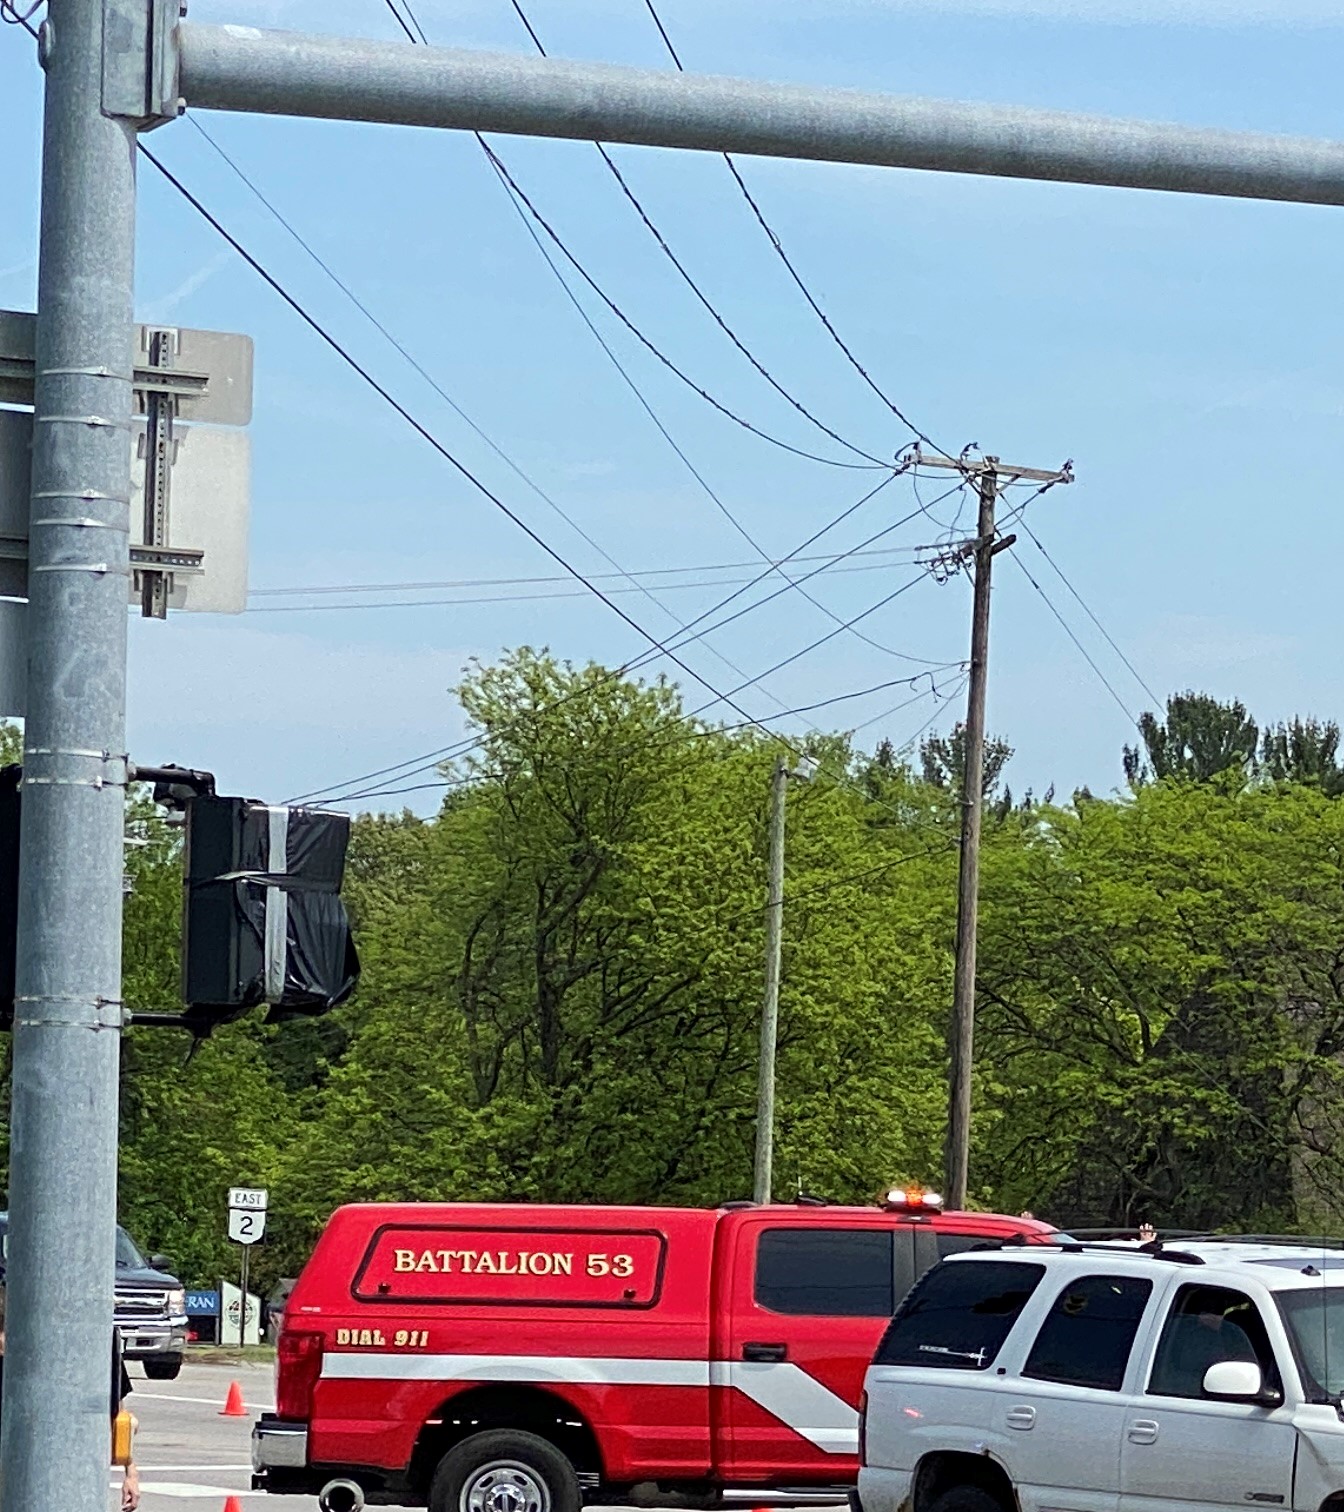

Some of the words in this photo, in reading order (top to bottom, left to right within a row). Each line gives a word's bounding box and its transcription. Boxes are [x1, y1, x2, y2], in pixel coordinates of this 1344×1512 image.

[235, 1193, 262, 1205] EAST
[239, 1216, 253, 1236] 2
[394, 1249, 573, 1275] BATTALION
[586, 1253, 634, 1277] 53
[337, 1328, 386, 1346] DIAL
[393, 1329, 429, 1347] 911
